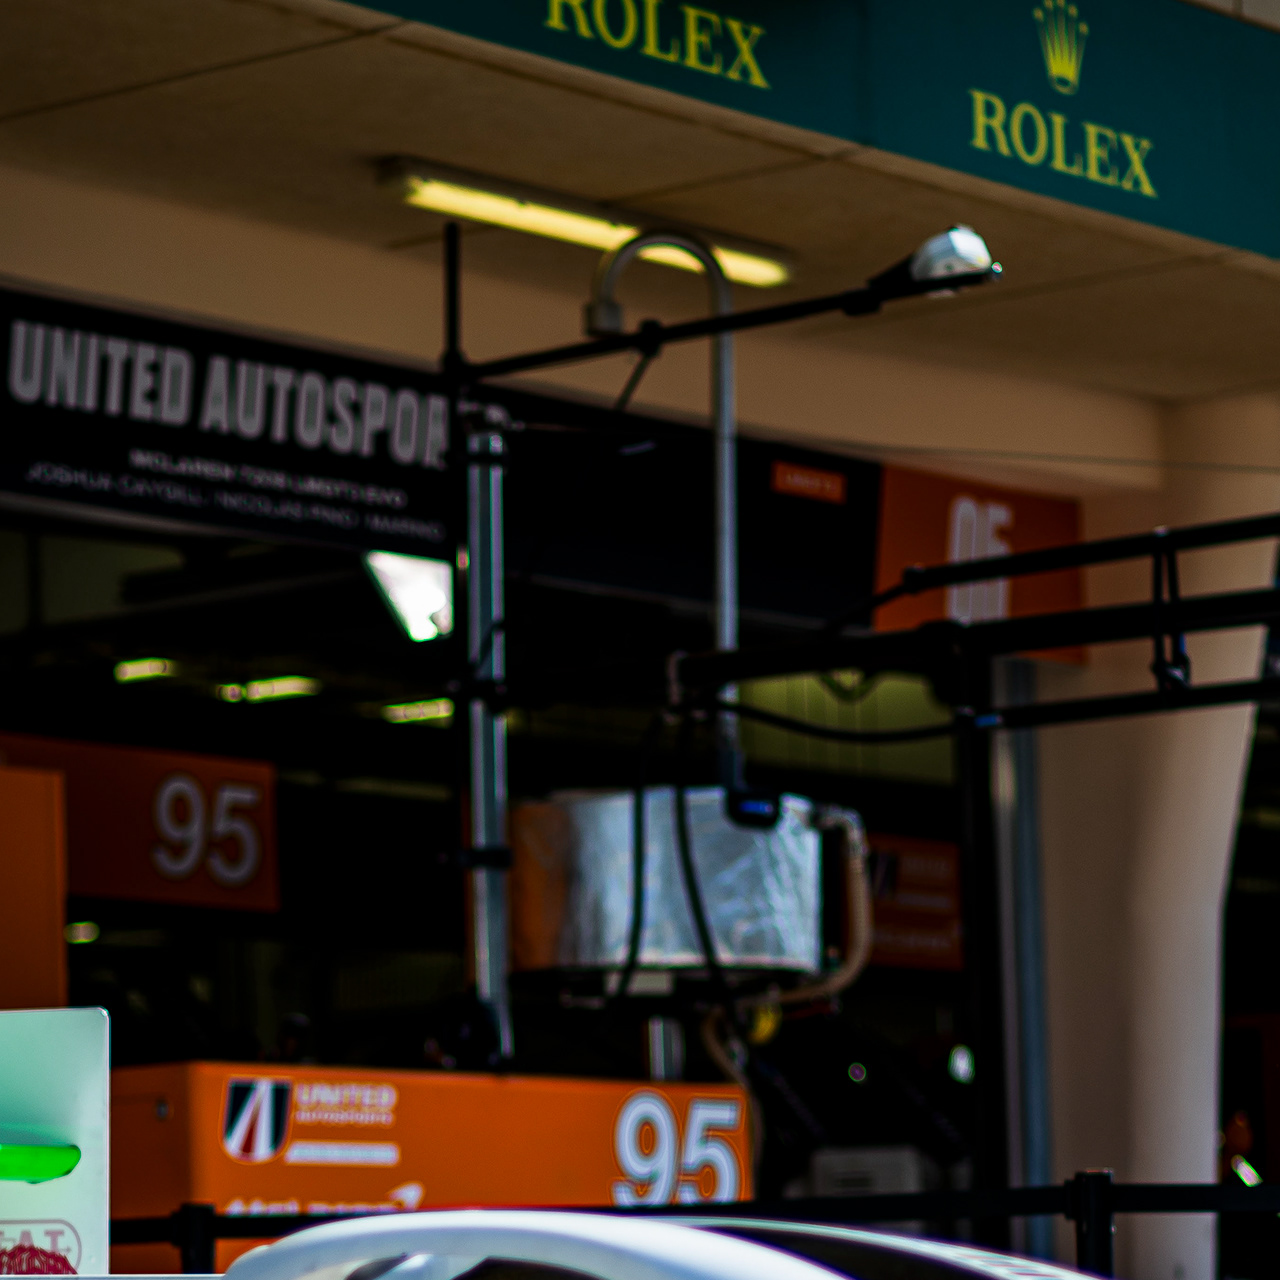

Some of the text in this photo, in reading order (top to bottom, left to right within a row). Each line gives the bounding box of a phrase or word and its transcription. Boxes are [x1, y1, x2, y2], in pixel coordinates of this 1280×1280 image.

[968, 89, 1158, 198] ROLEX
[9, 318, 195, 426] UNITED
[150, 774, 267, 888] 95
[612, 1089, 741, 1208] 95
